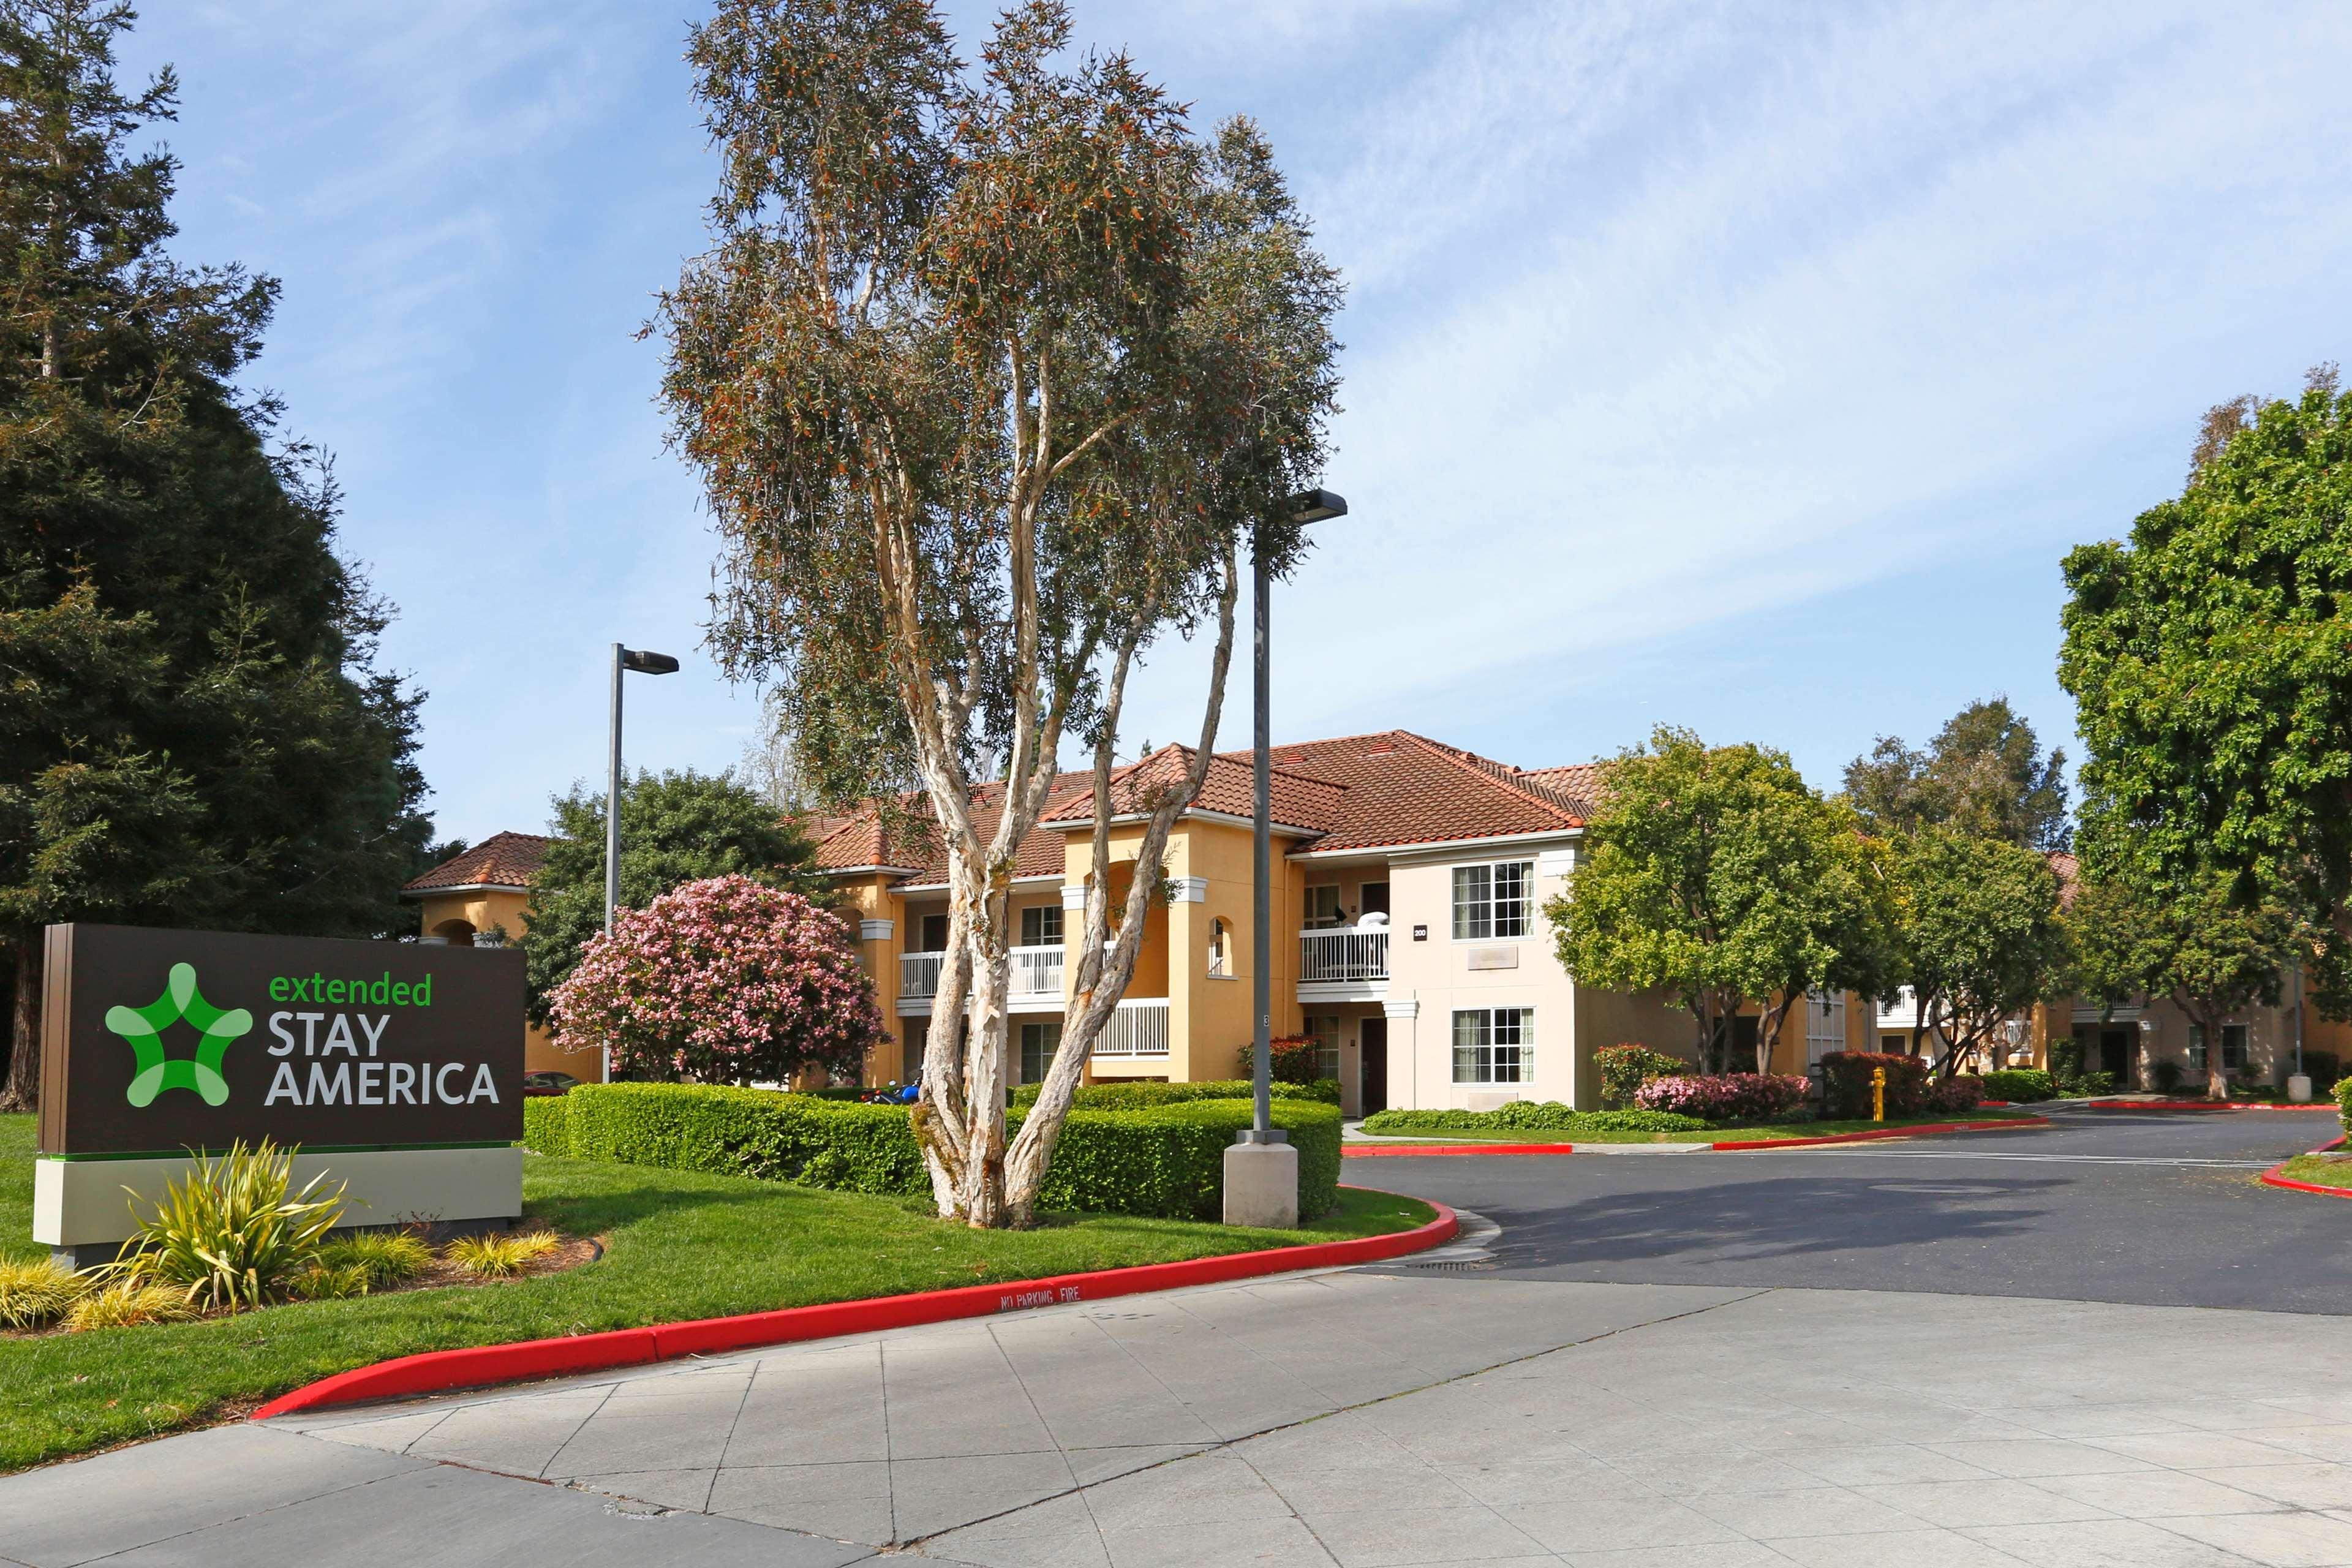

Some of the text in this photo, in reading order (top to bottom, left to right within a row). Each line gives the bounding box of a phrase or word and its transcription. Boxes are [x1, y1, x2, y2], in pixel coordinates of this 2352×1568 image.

[270, 971, 431, 1006] extended
[267, 1011, 391, 1056] STAY
[263, 1061, 500, 1106] AMERICA
[1016, 1290, 1053, 1307] PARKING
[1060, 1286, 1080, 1302] FIRE
